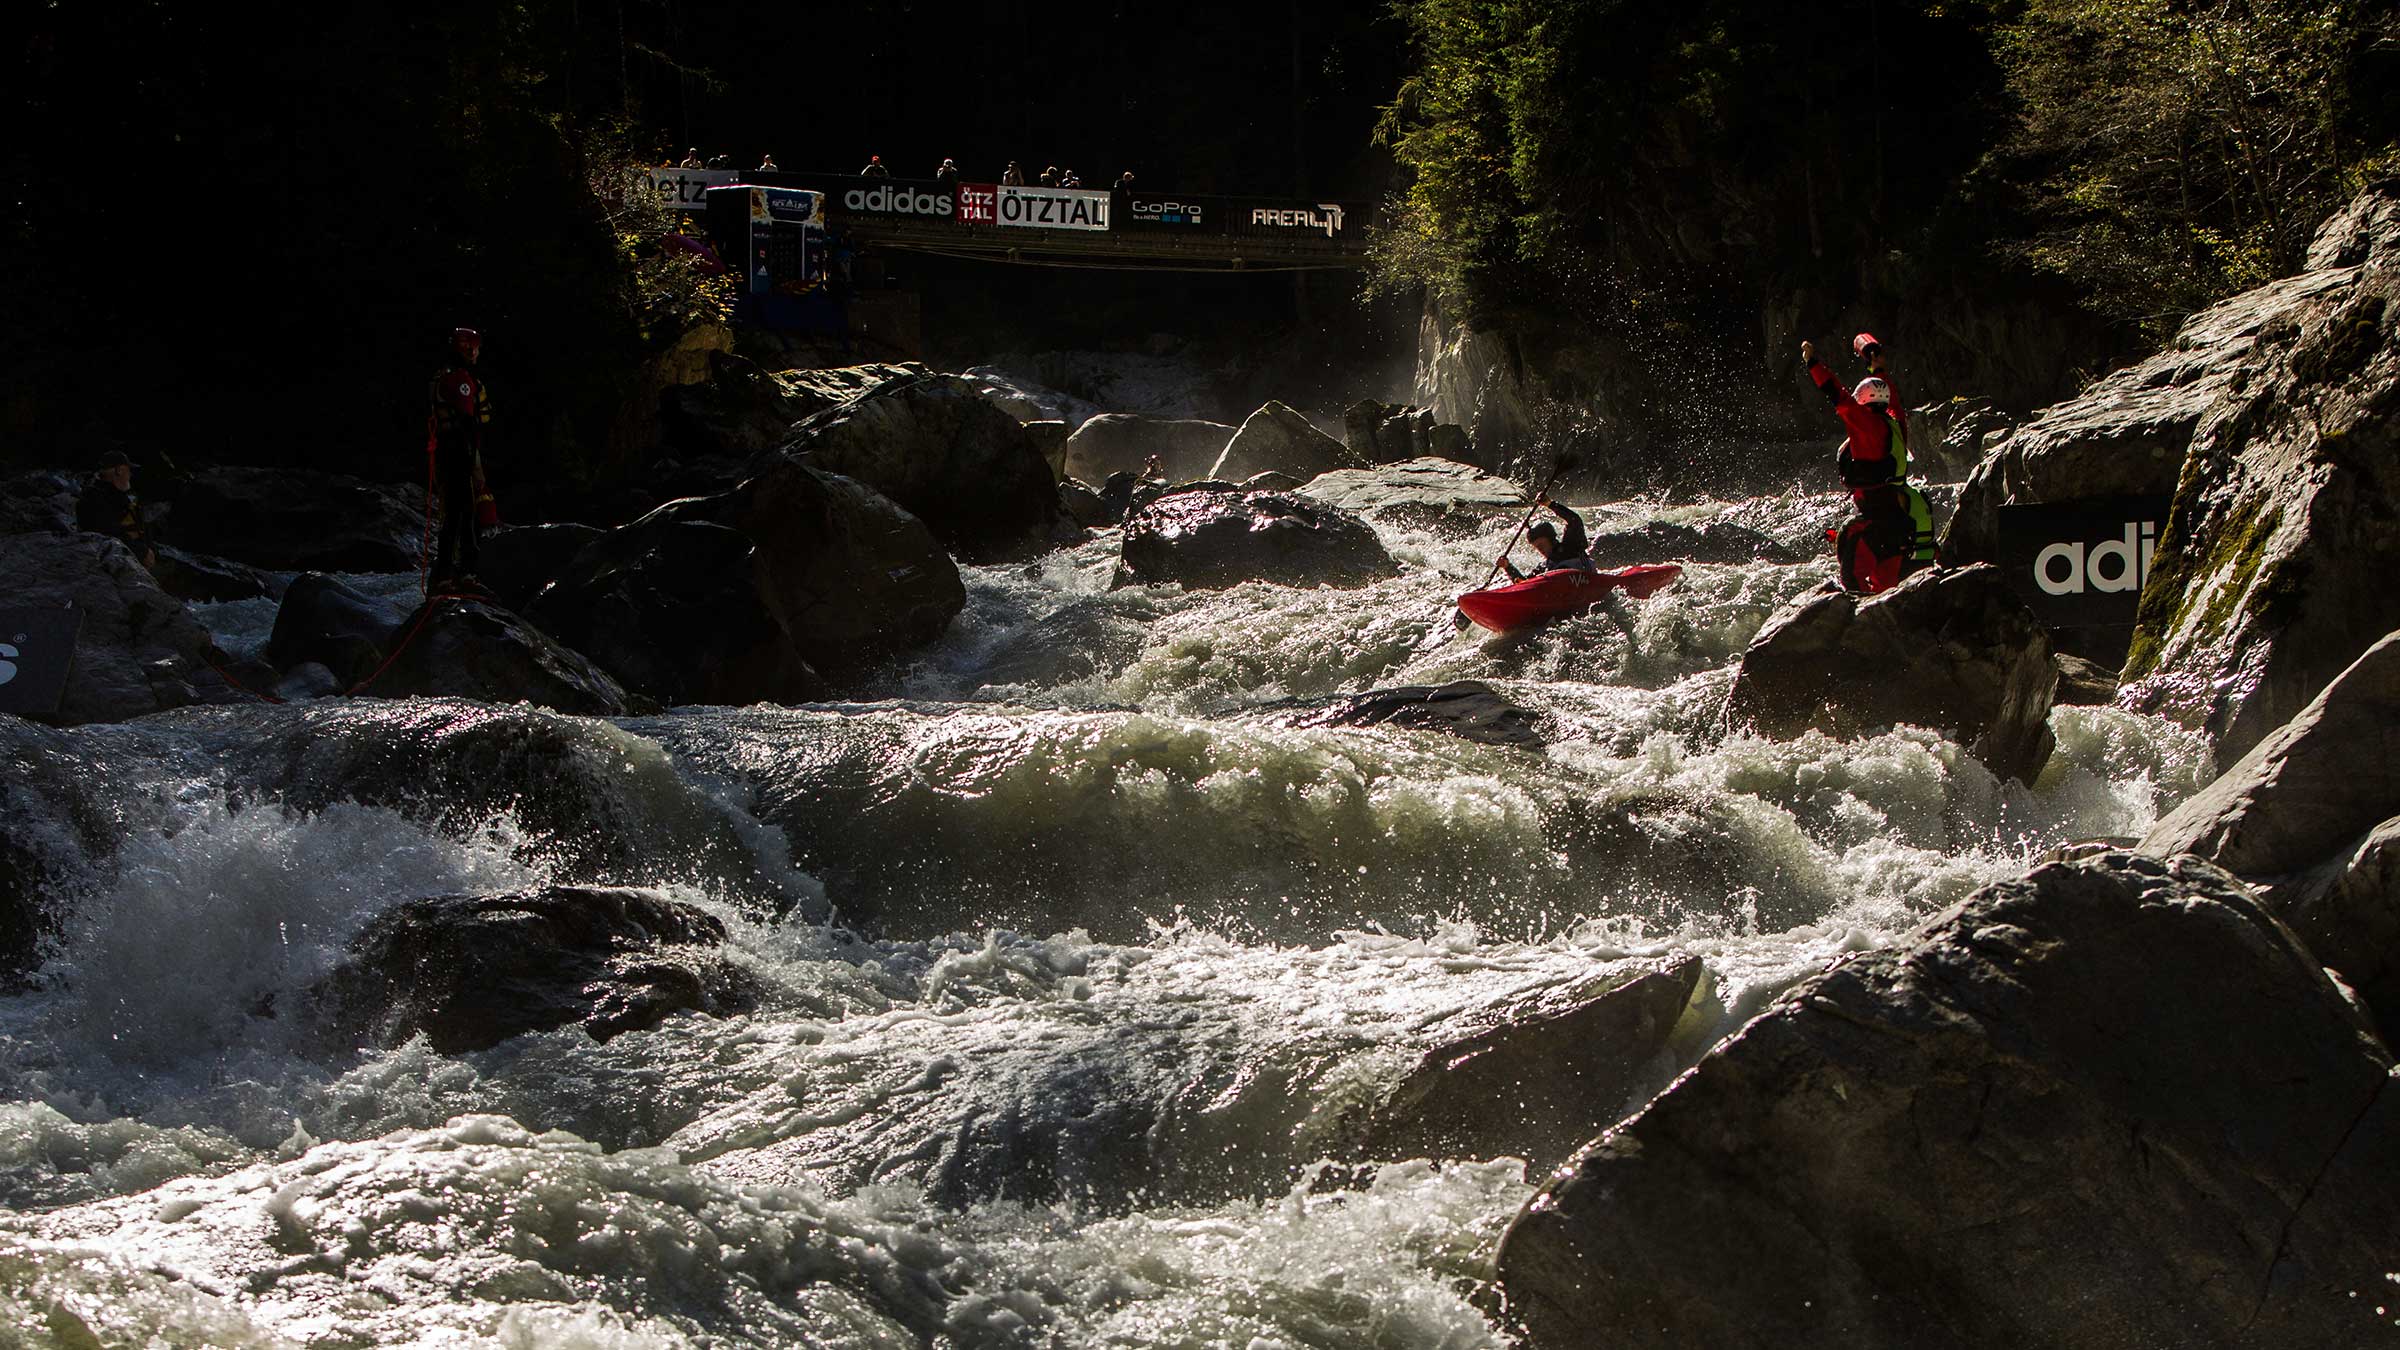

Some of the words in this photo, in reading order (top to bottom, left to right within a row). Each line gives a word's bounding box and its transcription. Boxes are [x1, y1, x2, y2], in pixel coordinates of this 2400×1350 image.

[844, 185, 953, 216] adidas
[960, 186, 993, 205] ÖTZ
[1002, 189, 1105, 226] ÖTZTAL
[1131, 200, 1202, 215] GoPro
[960, 206, 993, 220] TAL
[2033, 520, 2155, 596] adi
